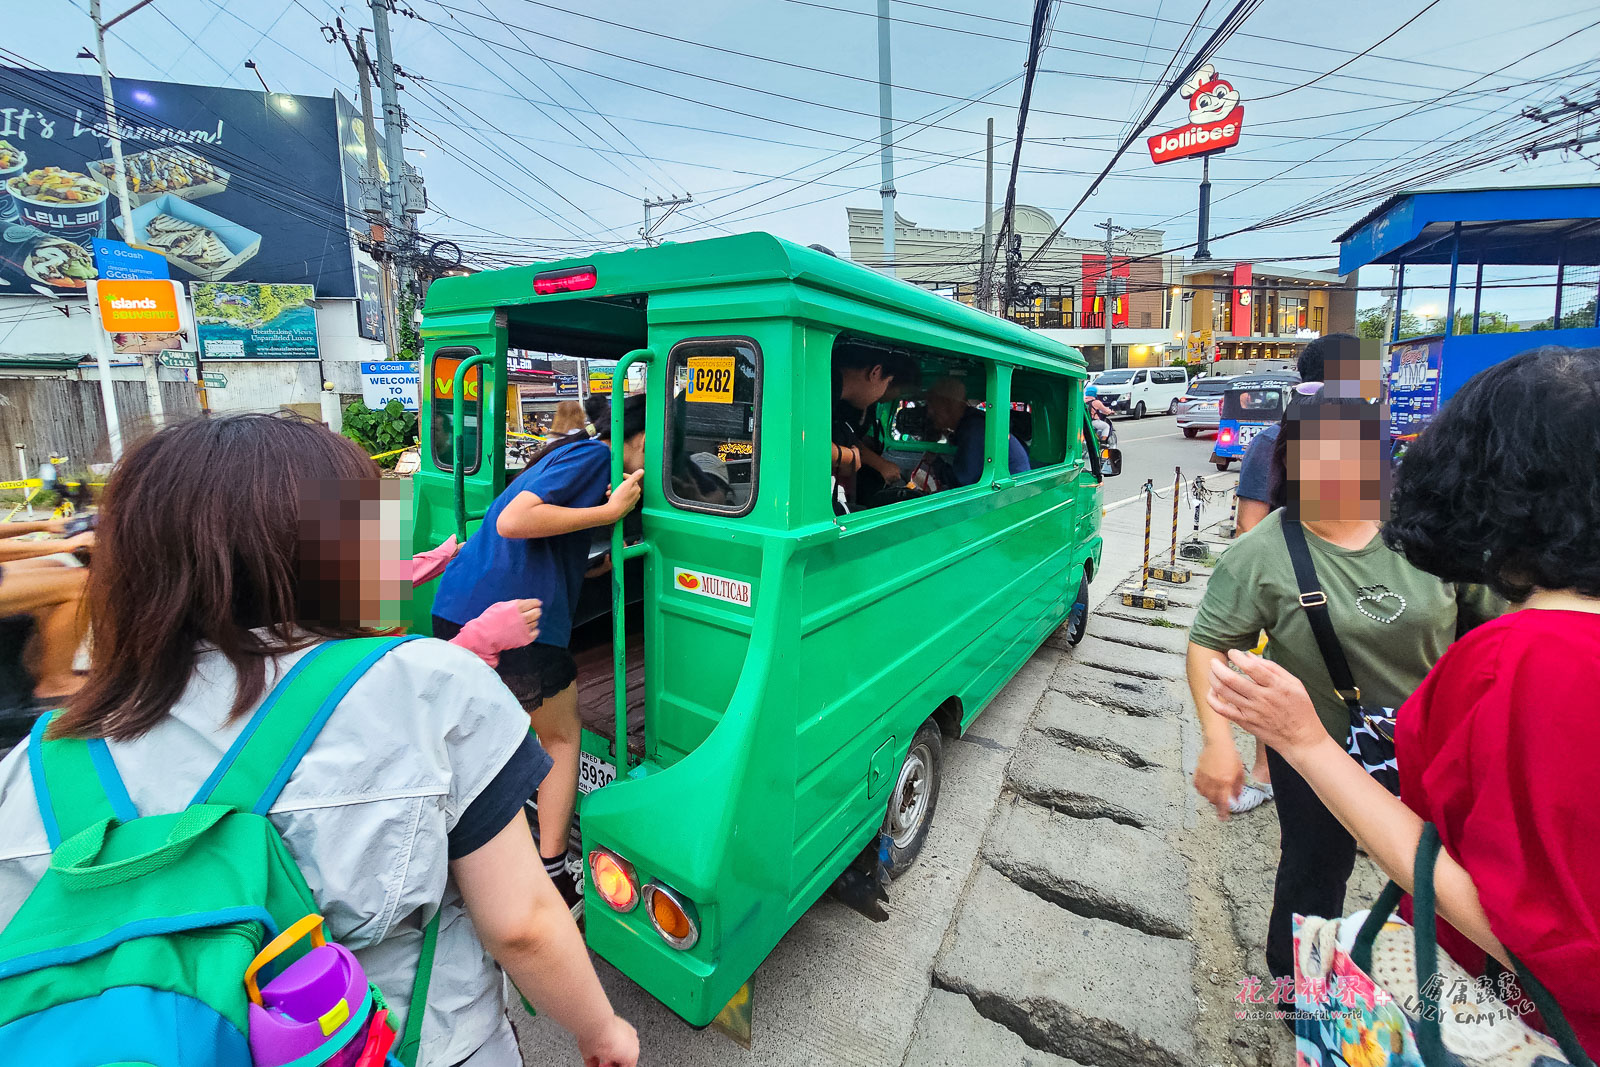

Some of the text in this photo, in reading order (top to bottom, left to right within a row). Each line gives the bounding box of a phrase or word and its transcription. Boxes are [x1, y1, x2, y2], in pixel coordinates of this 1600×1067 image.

[1, 107, 56, 140] It's
[1154, 124, 1236, 154] Jollibee
[113, 249, 144, 260] GCash
[106, 270, 139, 280] GCash
[111, 296, 157, 309] islands
[113, 310, 175, 320] souvenirs
[369, 377, 420, 385] WELCOME
[696, 368, 731, 393] C282
[388, 387, 403, 395] TO
[702, 576, 749, 603] MULTICAB
[581, 751, 598, 764] ERED
